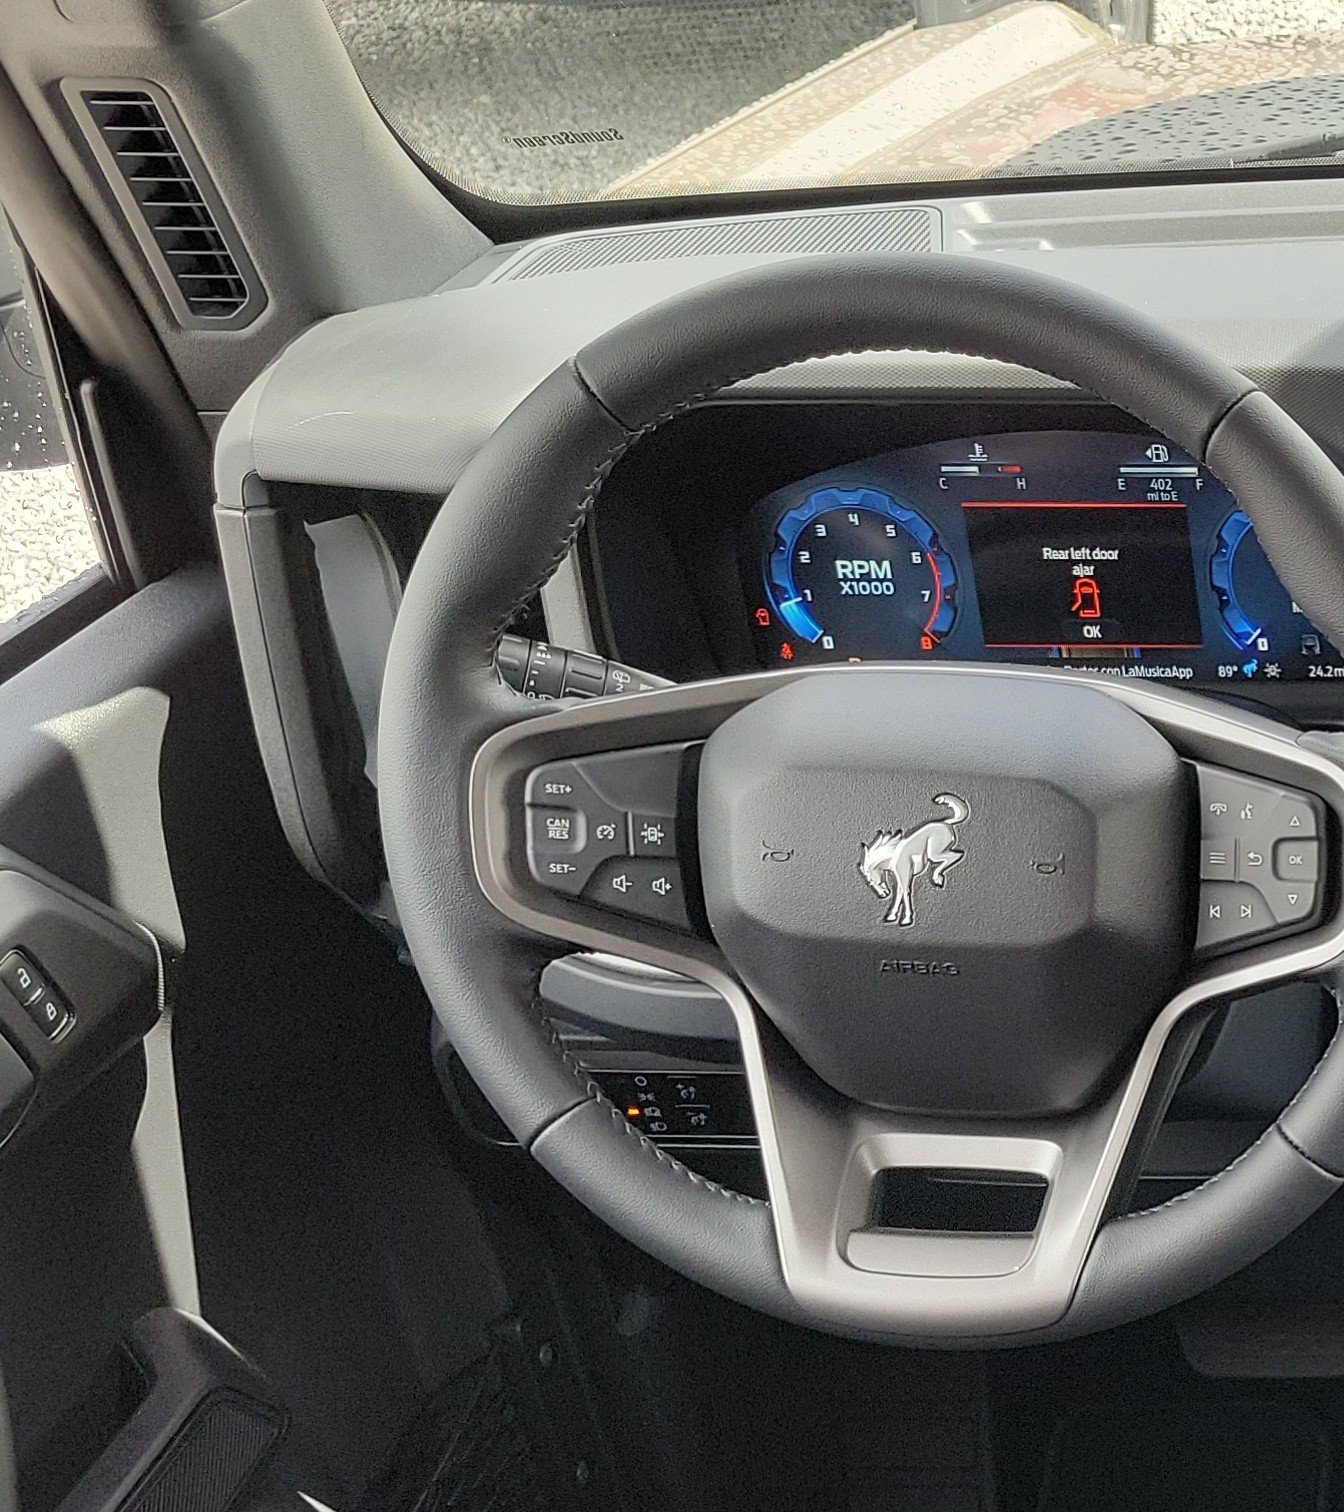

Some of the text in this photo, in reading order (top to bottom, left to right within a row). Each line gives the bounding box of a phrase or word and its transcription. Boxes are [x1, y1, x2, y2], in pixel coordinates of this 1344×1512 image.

[938, 477, 949, 490] C
[1016, 477, 1027, 490] H
[1117, 478, 1126, 491] E
[1150, 478, 1173, 491] 402
[1195, 478, 1204, 491] F
[1147, 491, 1178, 501] mi to E
[848, 512, 859, 526] 4
[815, 524, 827, 537] 3
[886, 524, 897, 537] 5
[798, 550, 811, 563] 2
[911, 551, 922, 564] 6
[1042, 546, 1119, 560] Rear left door
[835, 559, 893, 580] RPM
[1072, 563, 1095, 577] ajar
[840, 580, 895, 596] X1000
[803, 589, 813, 602] 1
[921, 590, 931, 602] 7
[1083, 625, 1102, 639] OK
[822, 635, 834, 650] 0
[921, 635, 933, 650] 8
[1257, 637, 1268, 651] 0
[1122, 665, 1194, 679] LaMusicaApp
[1218, 665, 1238, 677] 89°
[546, 818, 570, 828] CAN
[548, 830, 570, 840] RES
[1288, 855, 1303, 865] OK
[880, 958, 960, 977] AIRBAG
